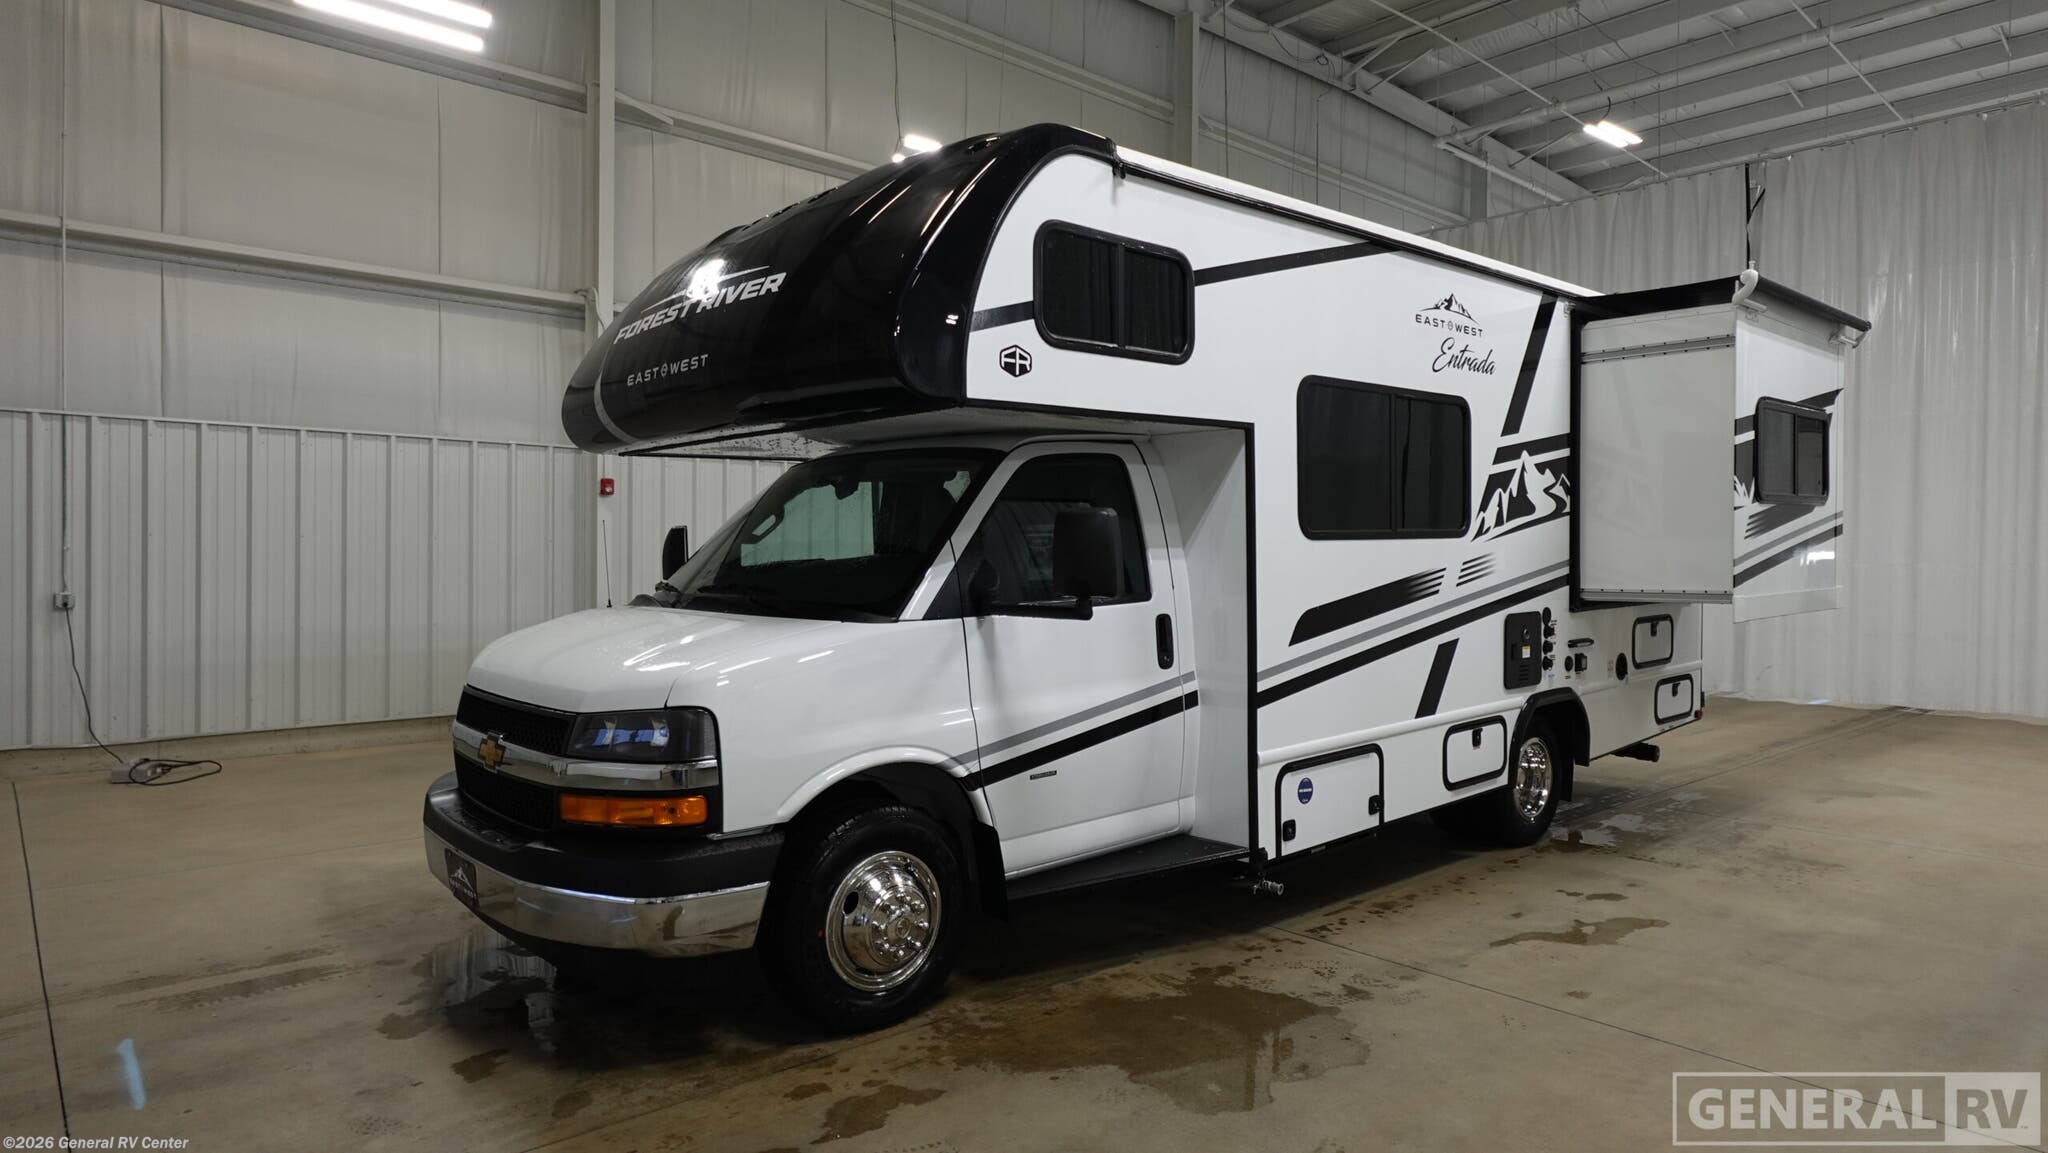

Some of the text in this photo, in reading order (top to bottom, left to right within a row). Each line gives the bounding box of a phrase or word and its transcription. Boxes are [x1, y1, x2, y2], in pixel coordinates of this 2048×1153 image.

[613, 272, 787, 344] FOREST RIVER
[1415, 313, 1483, 338] EAST WEST
[627, 354, 709, 386] EAST WEST
[1432, 337, 1496, 376] Entrada
